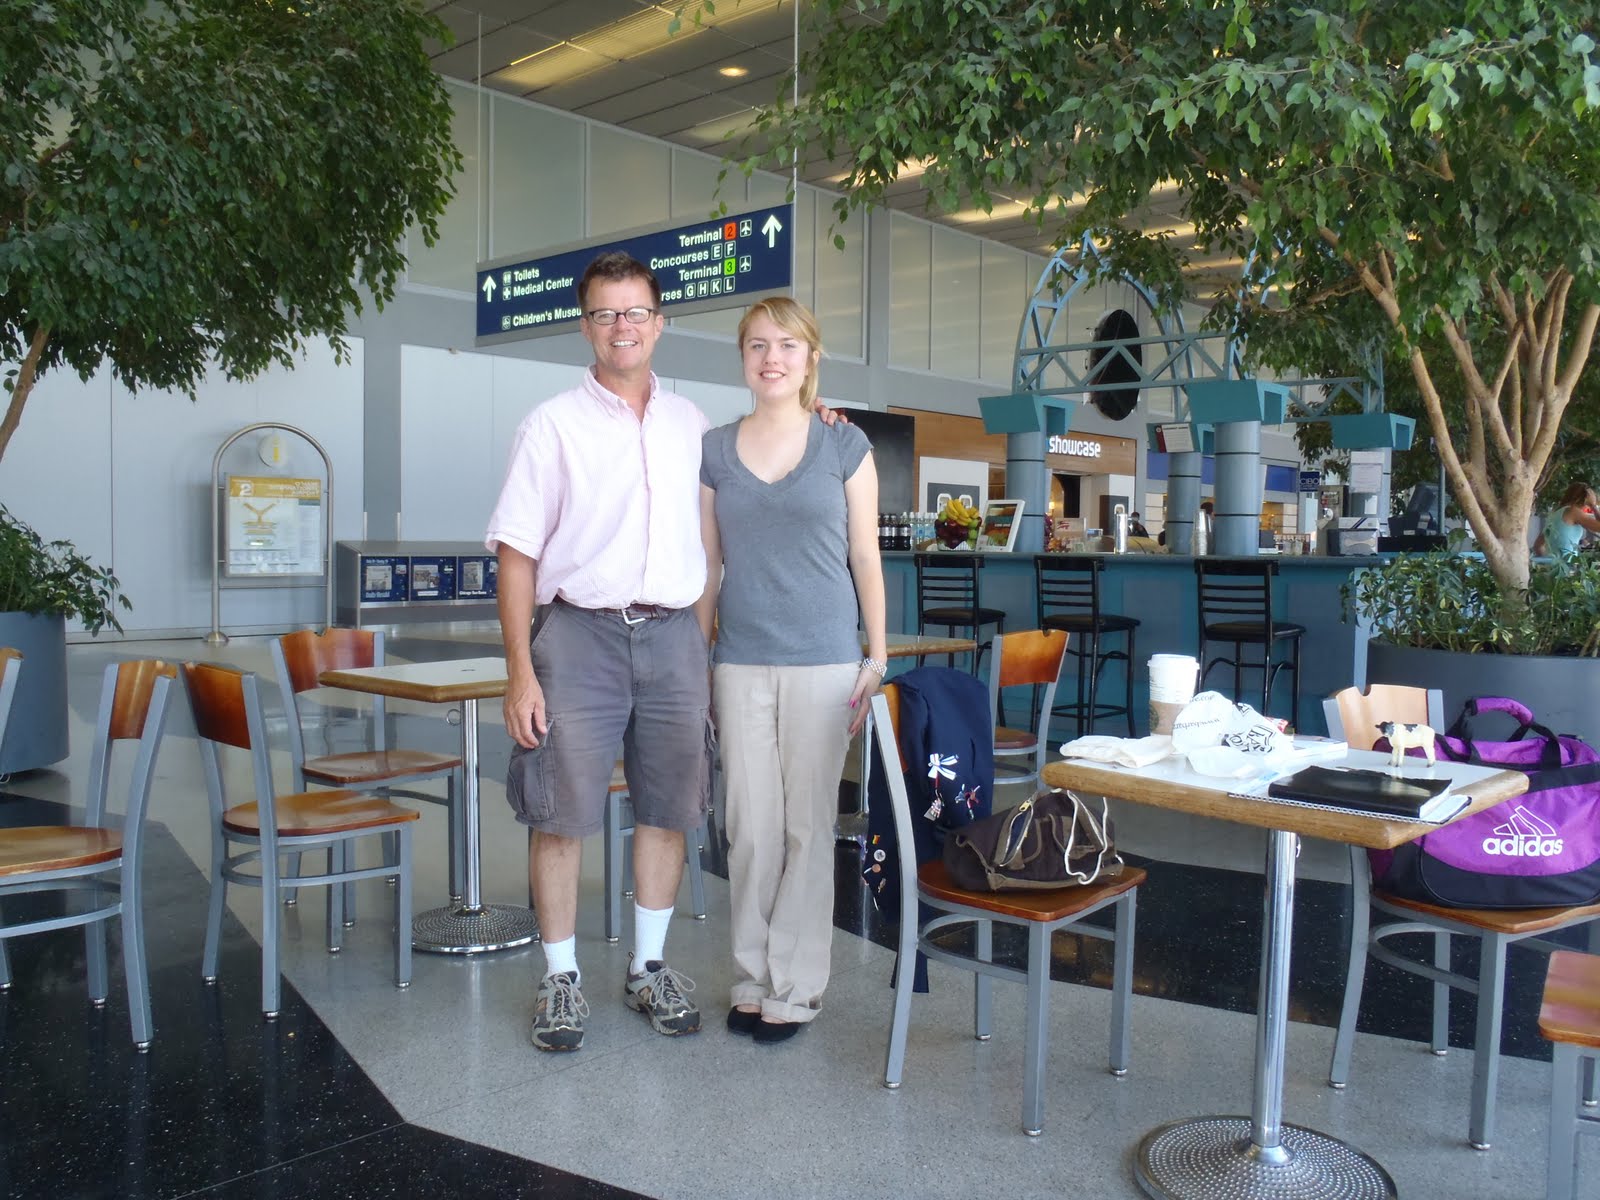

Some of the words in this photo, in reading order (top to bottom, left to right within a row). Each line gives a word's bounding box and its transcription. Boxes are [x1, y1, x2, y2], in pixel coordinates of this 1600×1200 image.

[679, 227, 722, 247] Terminal
[650, 250, 709, 270] Concourses
[713, 246, 721, 258] E
[727, 243, 734, 255] F
[513, 268, 540, 282] Toilets
[679, 263, 722, 281] Terminal
[513, 281, 544, 297] Medical
[545, 277, 574, 291] Center
[661, 289, 682, 301] rses
[686, 285, 694, 297] G
[699, 283, 707, 295] H
[712, 280, 720, 292] K
[726, 279, 733, 291] L
[512, 311, 552, 327] Children's
[554, 307, 582, 320] Museu
[1048, 435, 1101, 458] showcase
[240, 483, 252, 497] 2
[1482, 835, 1564, 857] adidas
